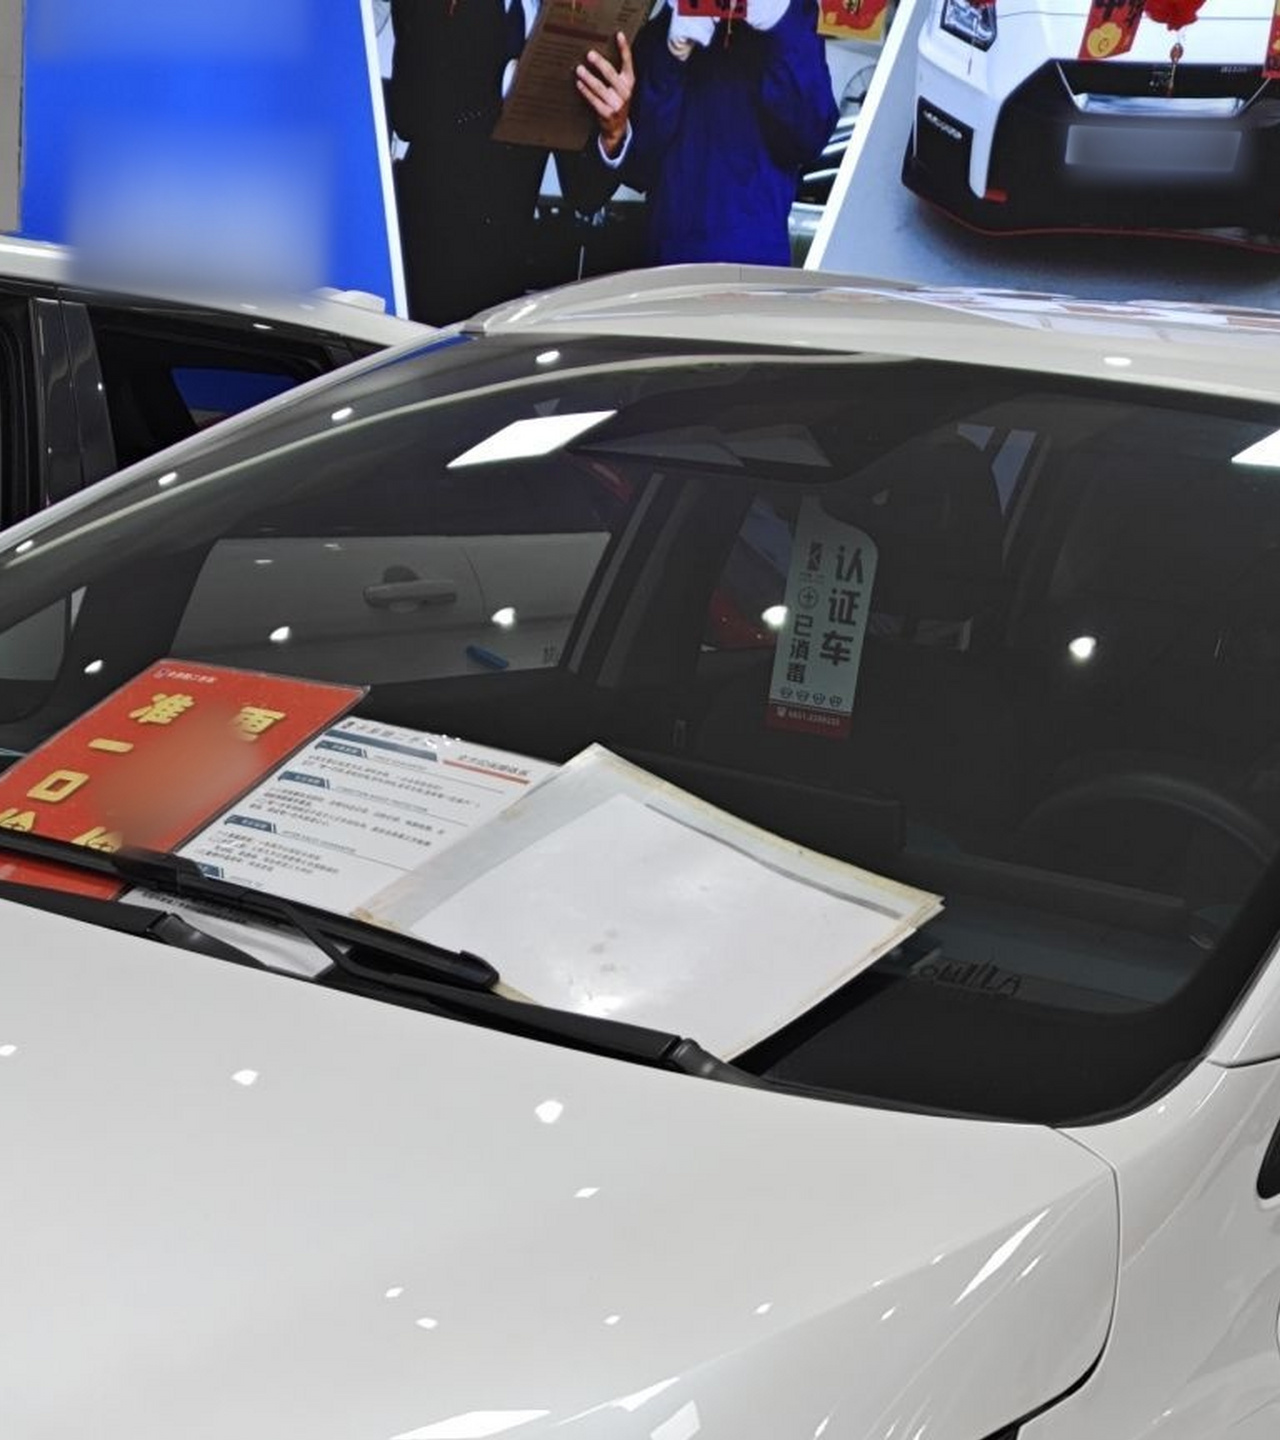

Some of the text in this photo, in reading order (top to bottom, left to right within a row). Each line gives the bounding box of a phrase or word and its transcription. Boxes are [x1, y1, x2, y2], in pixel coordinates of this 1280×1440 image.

[786, 614, 815, 685] 已消毒
[819, 544, 864, 667] 认证车
